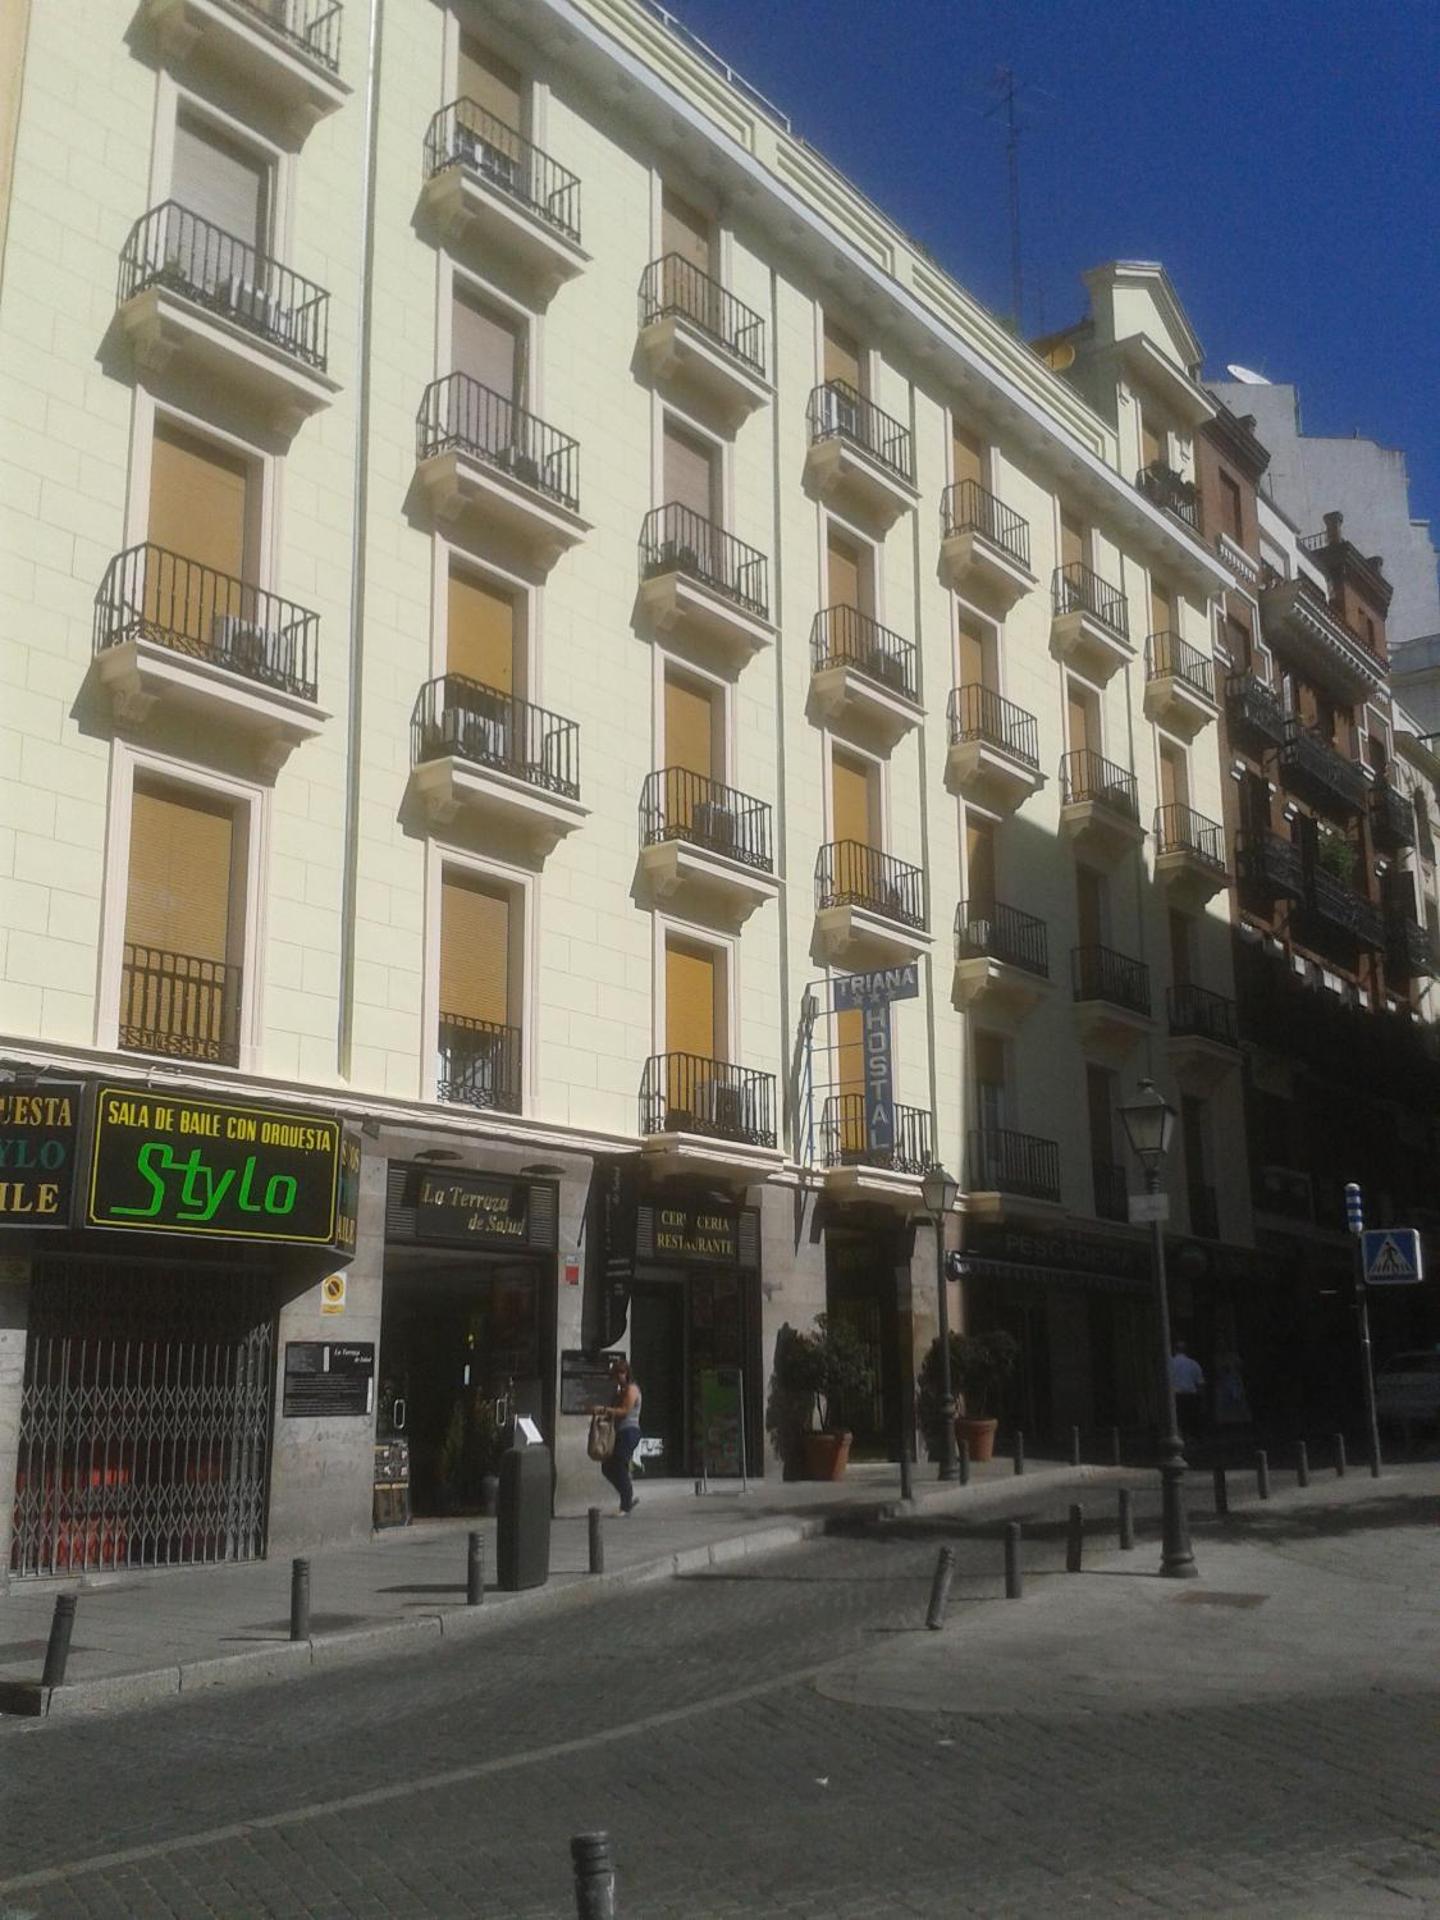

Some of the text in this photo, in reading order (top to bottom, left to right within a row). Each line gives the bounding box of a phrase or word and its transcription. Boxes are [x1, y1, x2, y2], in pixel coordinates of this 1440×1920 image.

[835, 966, 915, 995] TRIANA
[866, 1007, 889, 1149] HOSTAL
[108, 1100, 331, 1152] SALA DE BAILE CON ORQUESTA
[110, 1142, 298, 1221] Stylo
[424, 1183, 509, 1212] La Terraza
[468, 1213, 525, 1236] de Salud
